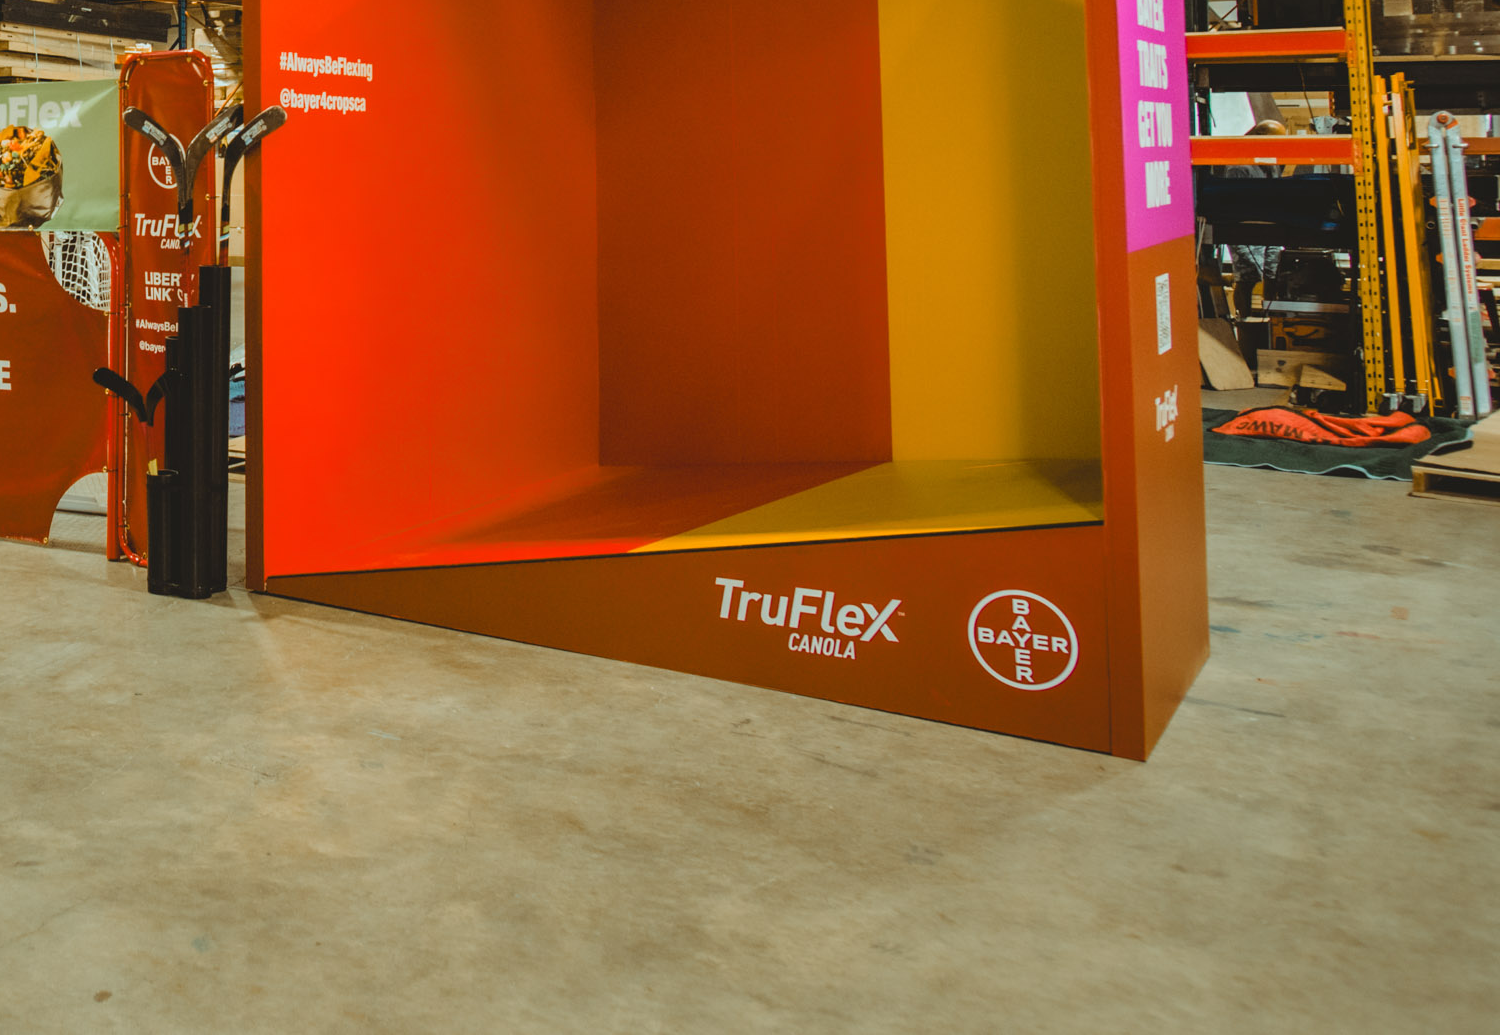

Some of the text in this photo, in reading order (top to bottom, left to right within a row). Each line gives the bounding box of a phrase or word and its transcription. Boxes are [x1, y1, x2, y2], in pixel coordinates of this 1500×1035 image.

[279, 51, 373, 82] #AlwaysBeFlexing
[1136, 39, 1168, 90] TRAITS
[279, 88, 367, 115] @bayer4cropsca
[1137, 100, 1174, 148] GET YOU
[1145, 160, 1172, 208] MORE
[160, 238, 182, 250] CANO
[1462, 238, 1471, 262] Ladder
[144, 271, 183, 287] LIBER
[1464, 263, 1474, 295] Systems
[135, 318, 179, 333] #AlwaysBe
[787, 632, 856, 660] CANOLA
[977, 627, 1070, 654] BAYER
[1011, 598, 1035, 683] BAYER
